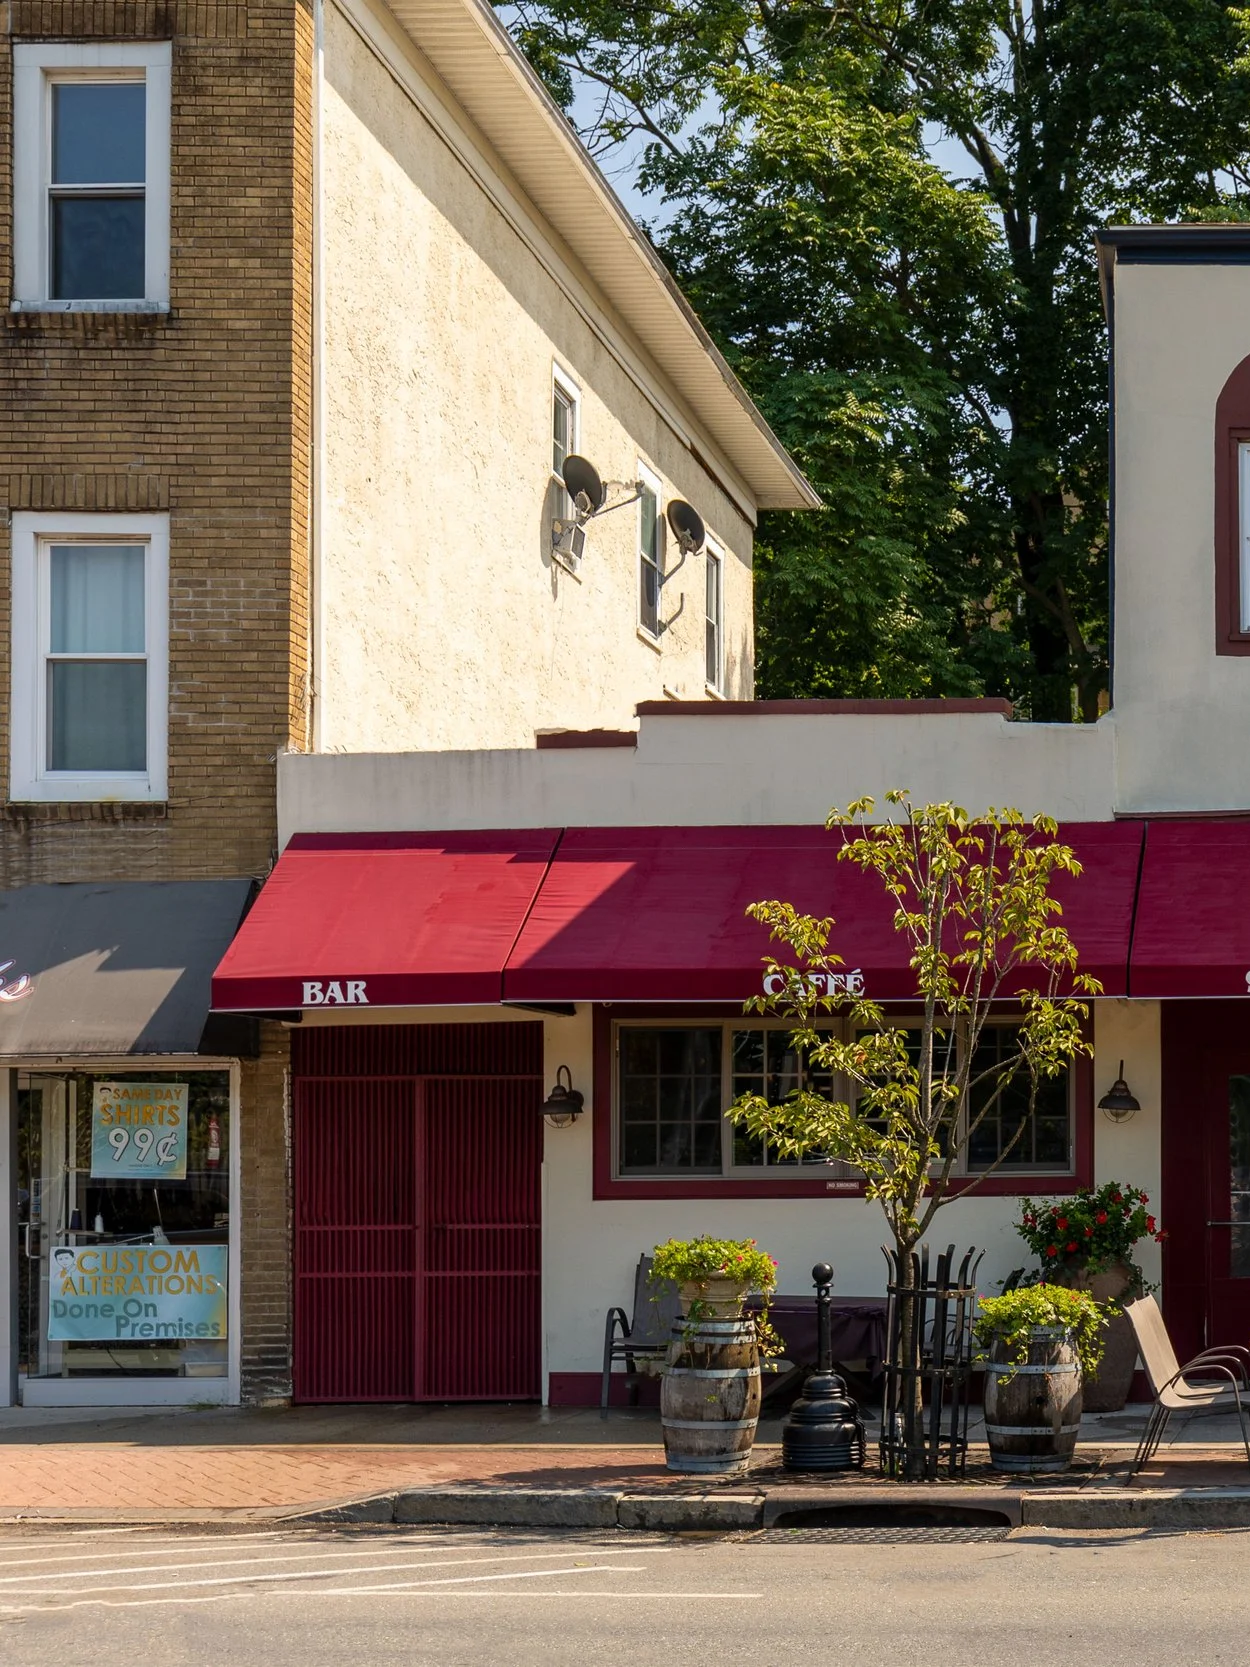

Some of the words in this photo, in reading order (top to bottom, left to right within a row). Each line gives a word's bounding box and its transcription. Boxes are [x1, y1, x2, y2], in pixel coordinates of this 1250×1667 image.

[302, 980, 370, 1004] BAR
[113, 1088, 151, 1101] SAME
[155, 1088, 183, 1101] DAY
[100, 1103, 181, 1126] SHIRTS
[108, 1127, 178, 1166] 99¢
[76, 1250, 200, 1274] CUSTOM
[60, 1275, 218, 1296] ALTERATIONS
[53, 1299, 115, 1318] Done
[123, 1298, 158, 1318] On
[115, 1315, 221, 1337] Premises
